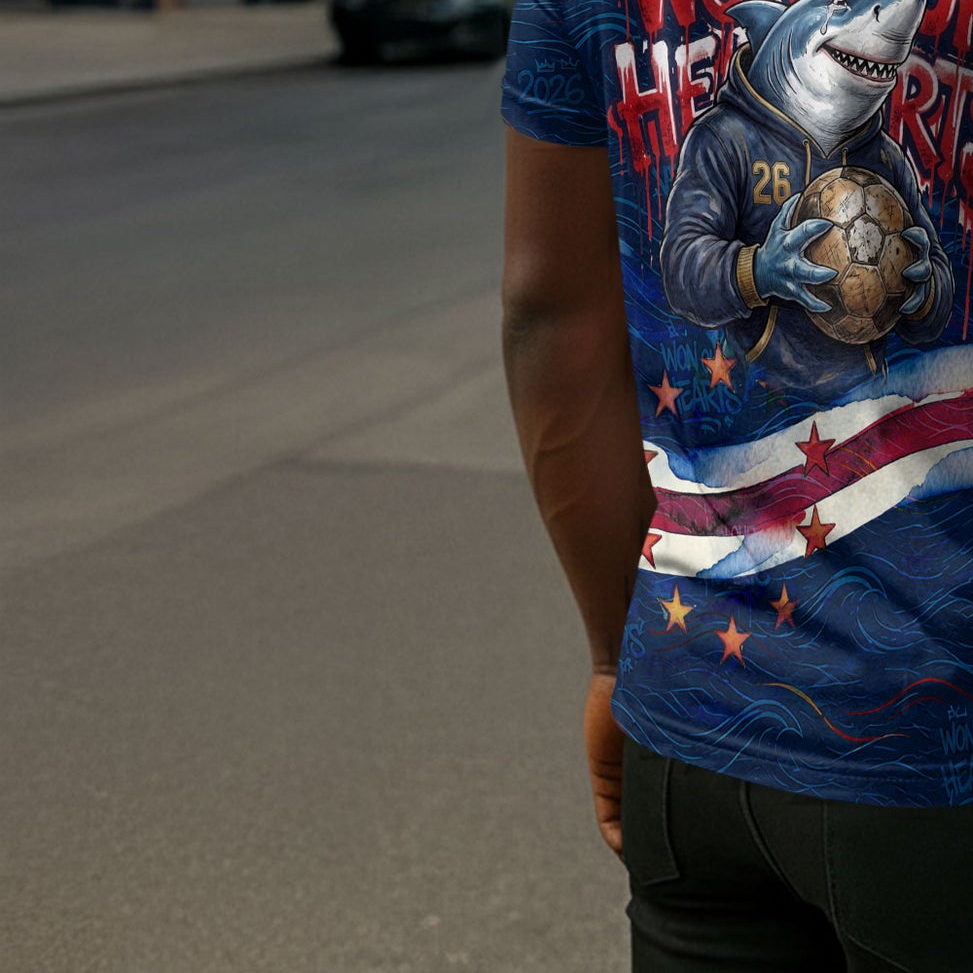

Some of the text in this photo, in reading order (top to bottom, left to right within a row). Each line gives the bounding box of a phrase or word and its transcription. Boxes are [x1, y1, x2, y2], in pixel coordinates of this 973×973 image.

[517, 69, 586, 105] 2026
[752, 160, 792, 206] 26
[660, 340, 700, 373] WON
